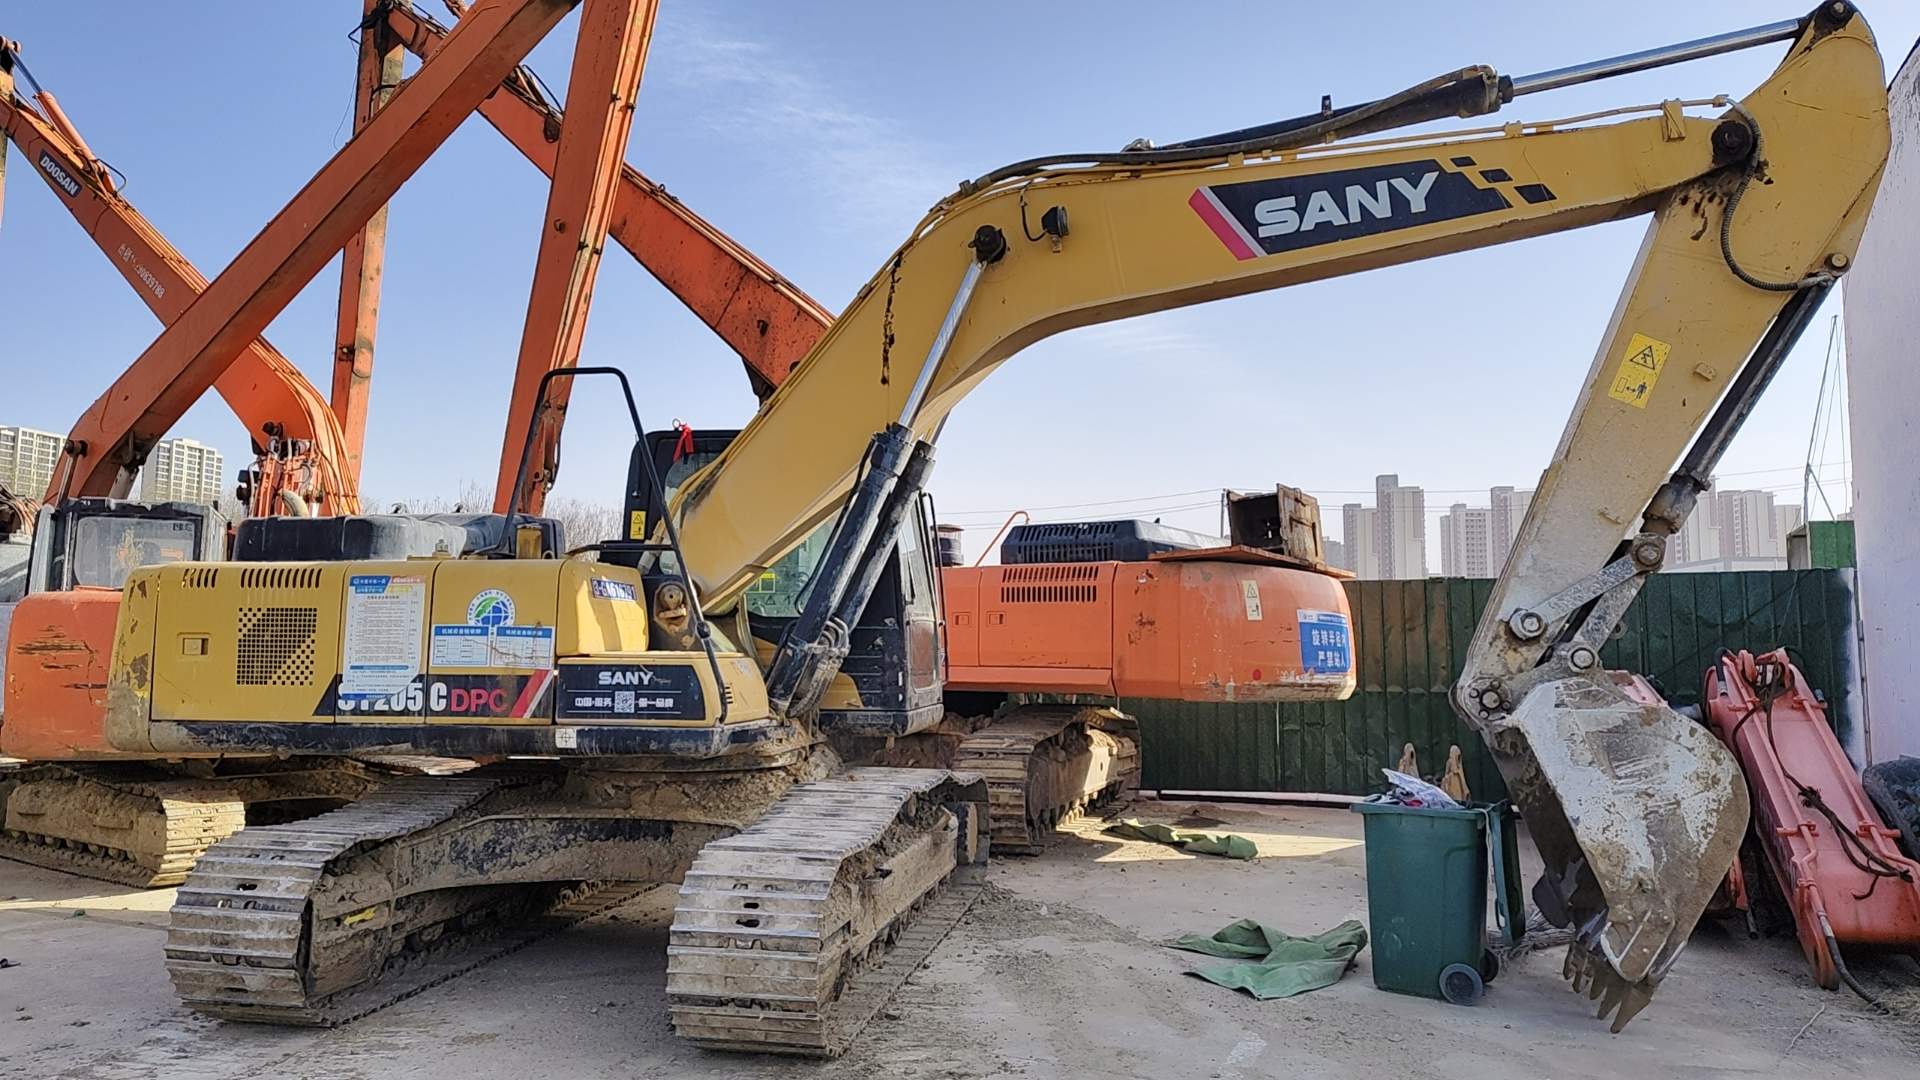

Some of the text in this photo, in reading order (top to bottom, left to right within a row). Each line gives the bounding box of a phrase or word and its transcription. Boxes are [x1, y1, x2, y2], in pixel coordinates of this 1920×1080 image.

[40, 155, 79, 195] DOOSAN
[1254, 171, 1440, 238] SANY
[598, 671, 654, 685] SANY
